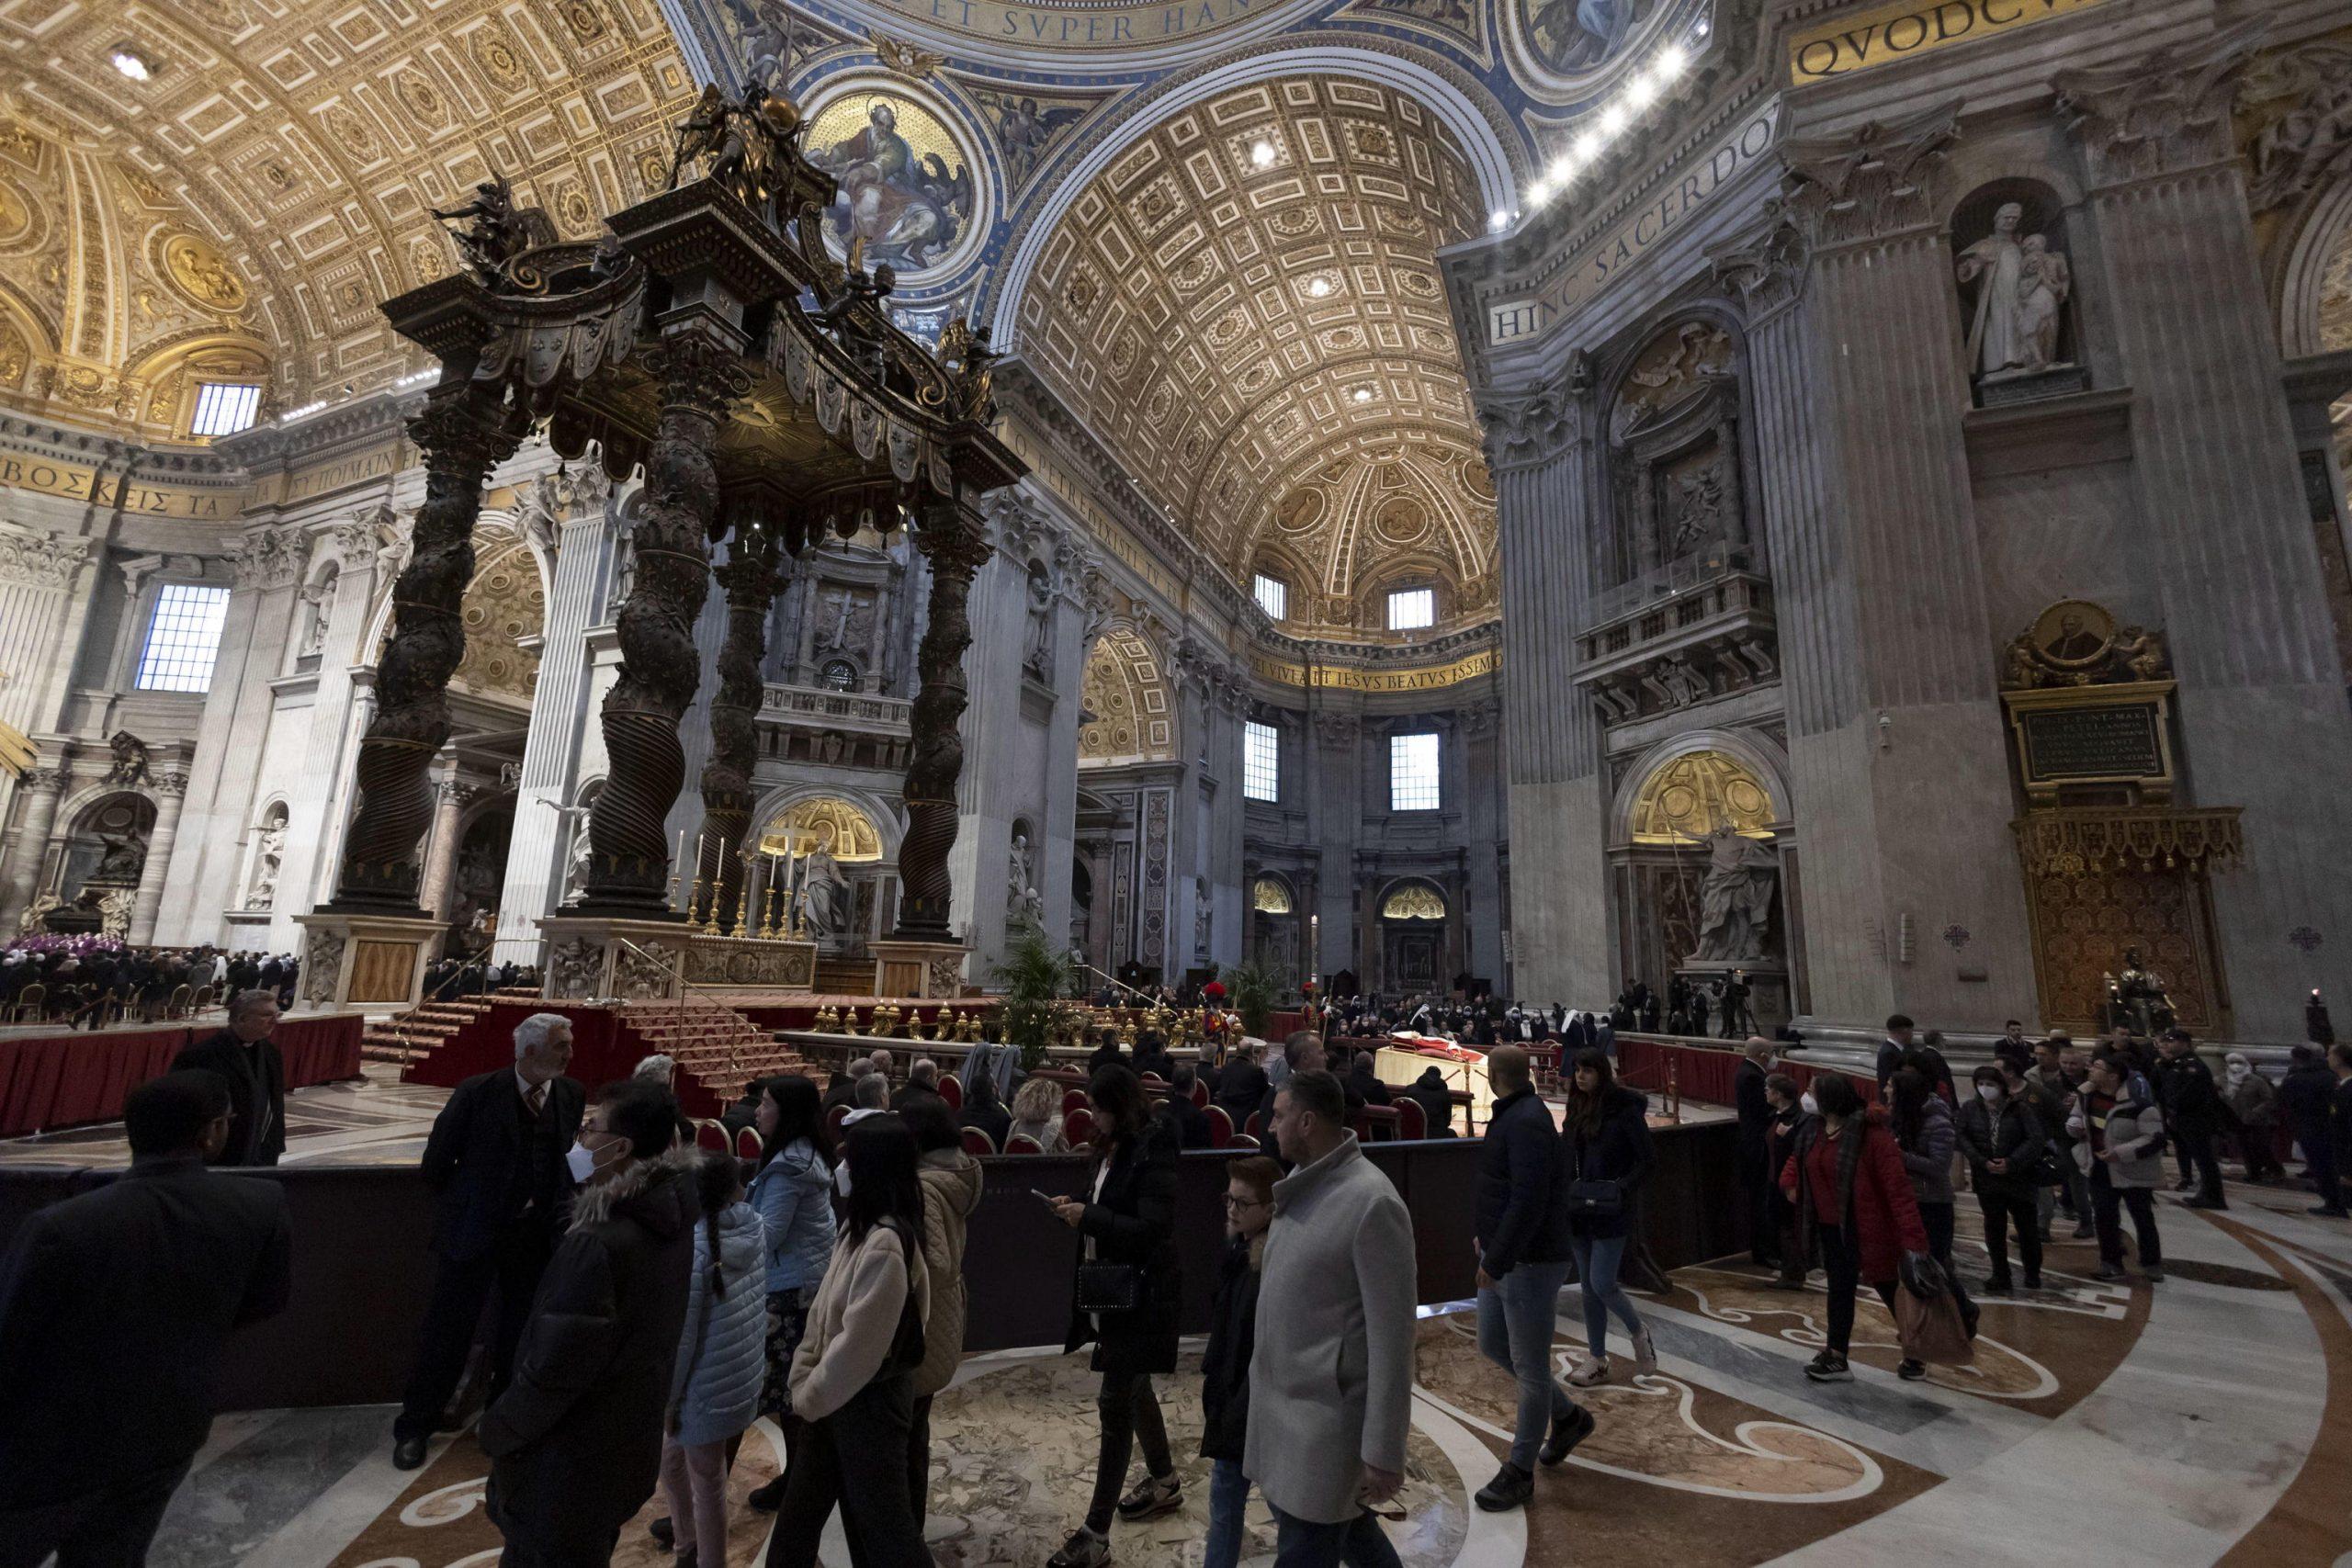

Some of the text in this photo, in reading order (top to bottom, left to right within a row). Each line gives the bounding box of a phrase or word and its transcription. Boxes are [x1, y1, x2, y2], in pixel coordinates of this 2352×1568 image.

[931, 0, 977, 27] ET
[1001, 10, 1134, 42] SVPER
[1796, 0, 2090, 77] QVODC
[1494, 102, 1781, 339] HINC SACERDO
[1337, 671, 1382, 690] IESVS
[1387, 670, 1447, 690] BEATVS
